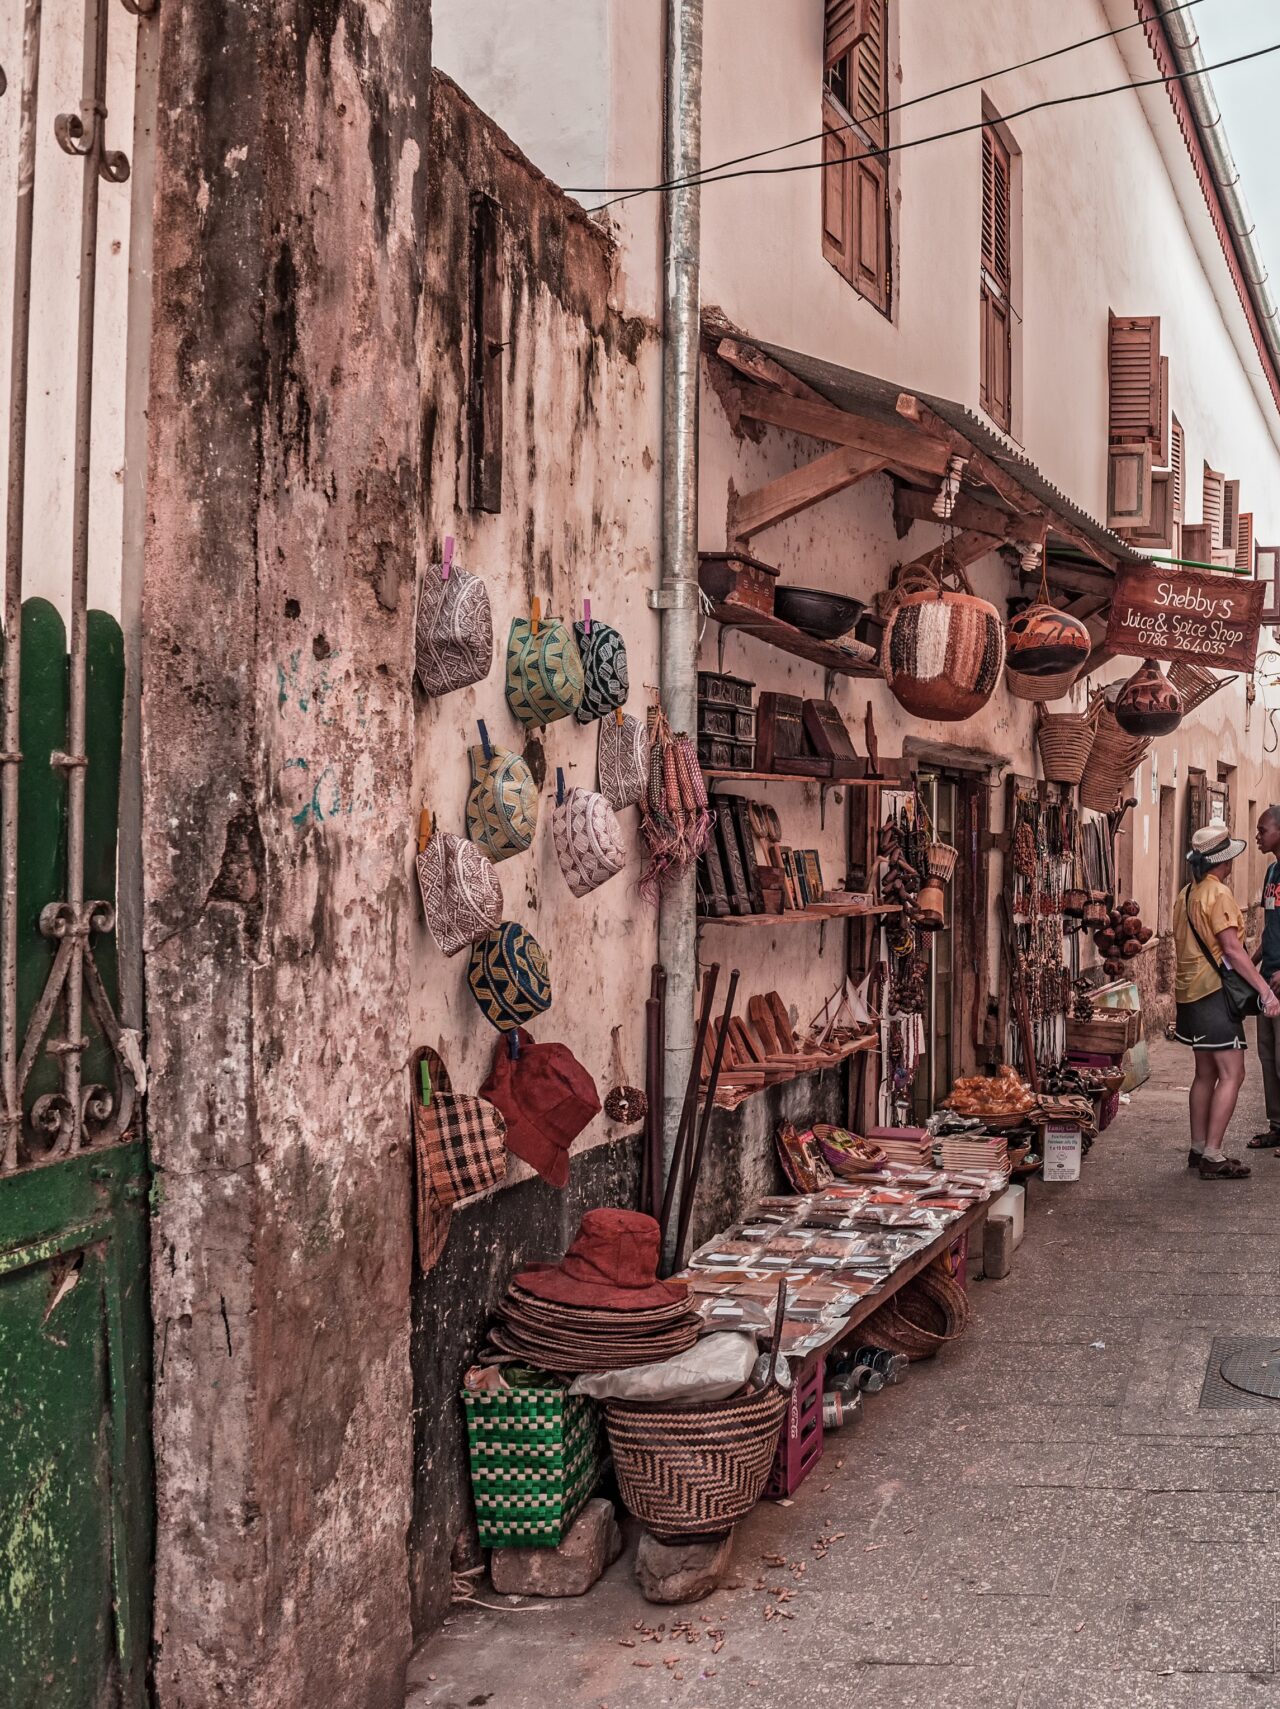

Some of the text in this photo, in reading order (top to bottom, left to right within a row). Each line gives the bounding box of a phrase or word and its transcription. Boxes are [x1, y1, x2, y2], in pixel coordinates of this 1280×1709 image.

[1121, 608, 1243, 648] Juice & Spice Shop
[1138, 631, 1227, 656] 0786 264035
